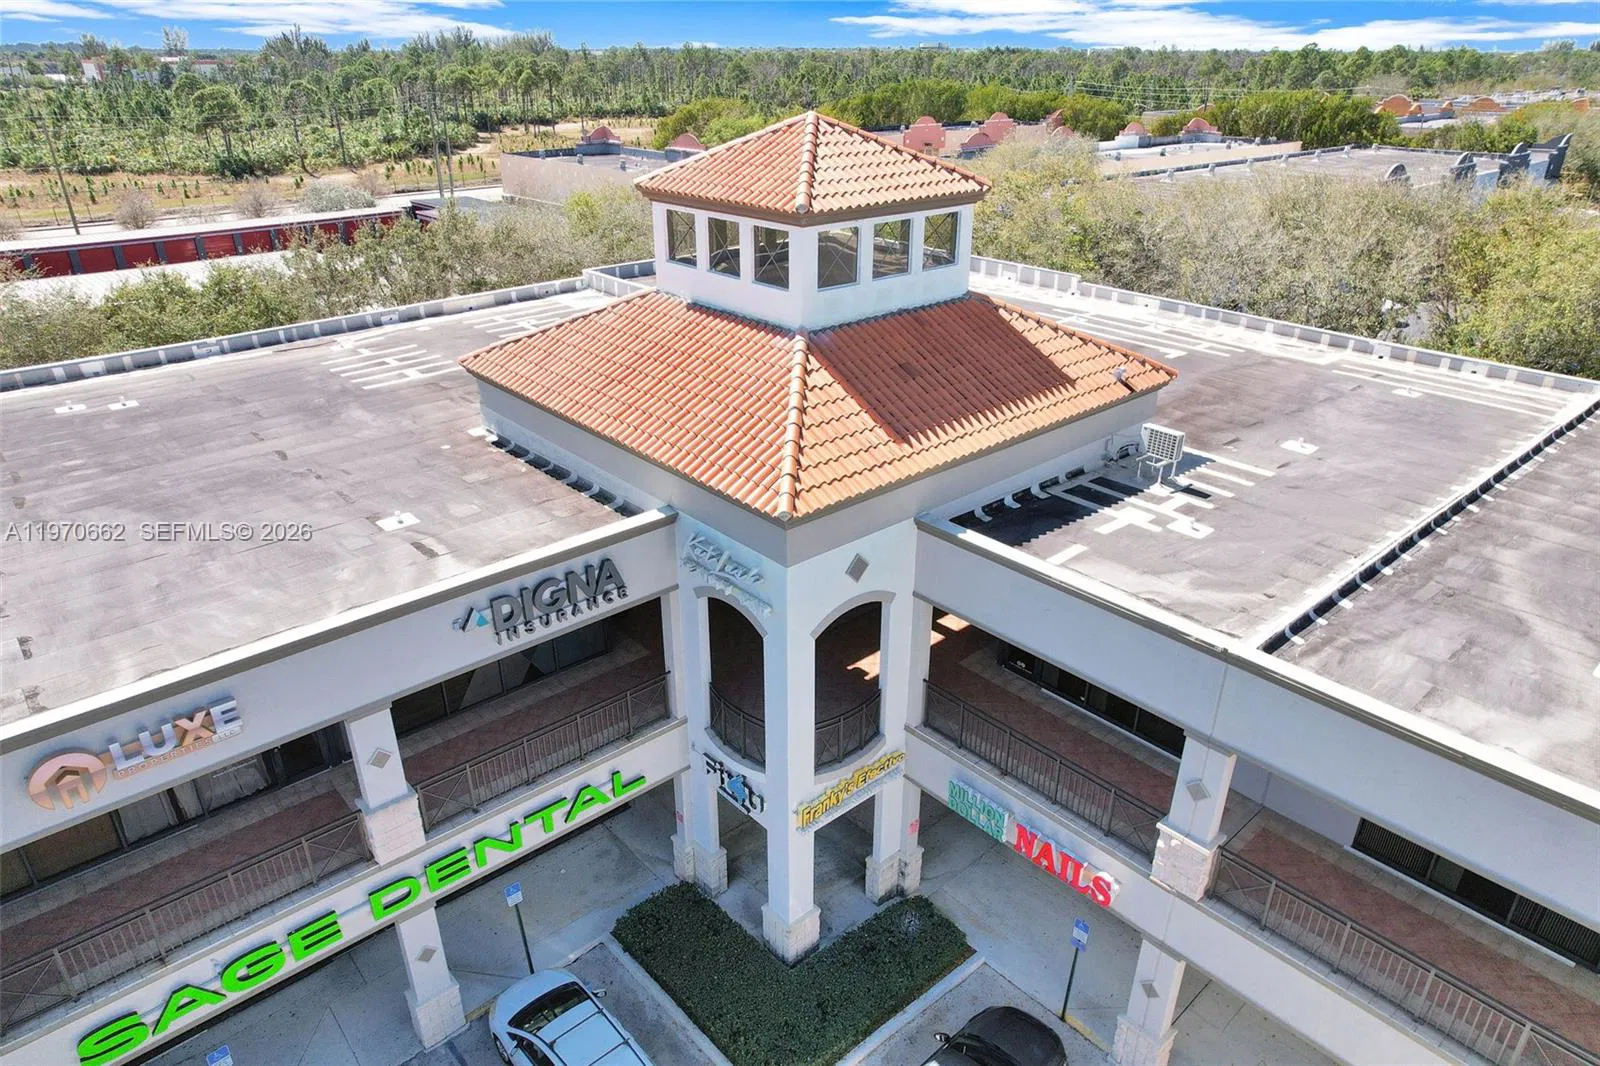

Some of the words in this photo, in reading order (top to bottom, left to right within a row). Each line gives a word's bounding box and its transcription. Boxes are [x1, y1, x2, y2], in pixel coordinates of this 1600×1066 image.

[489, 557, 625, 632] DIGNA
[493, 585, 629, 646] INSURANCE
[109, 699, 243, 770] LUXE
[118, 738, 212, 777] PROPERTIES
[797, 779, 857, 829] Franky's
[947, 797, 1005, 842] DOLLAR
[948, 780, 1006, 828] MILLION
[1013, 822, 1115, 908] NAILS
[77, 910, 343, 1066] SAGE
[368, 770, 647, 921] DENTAL
